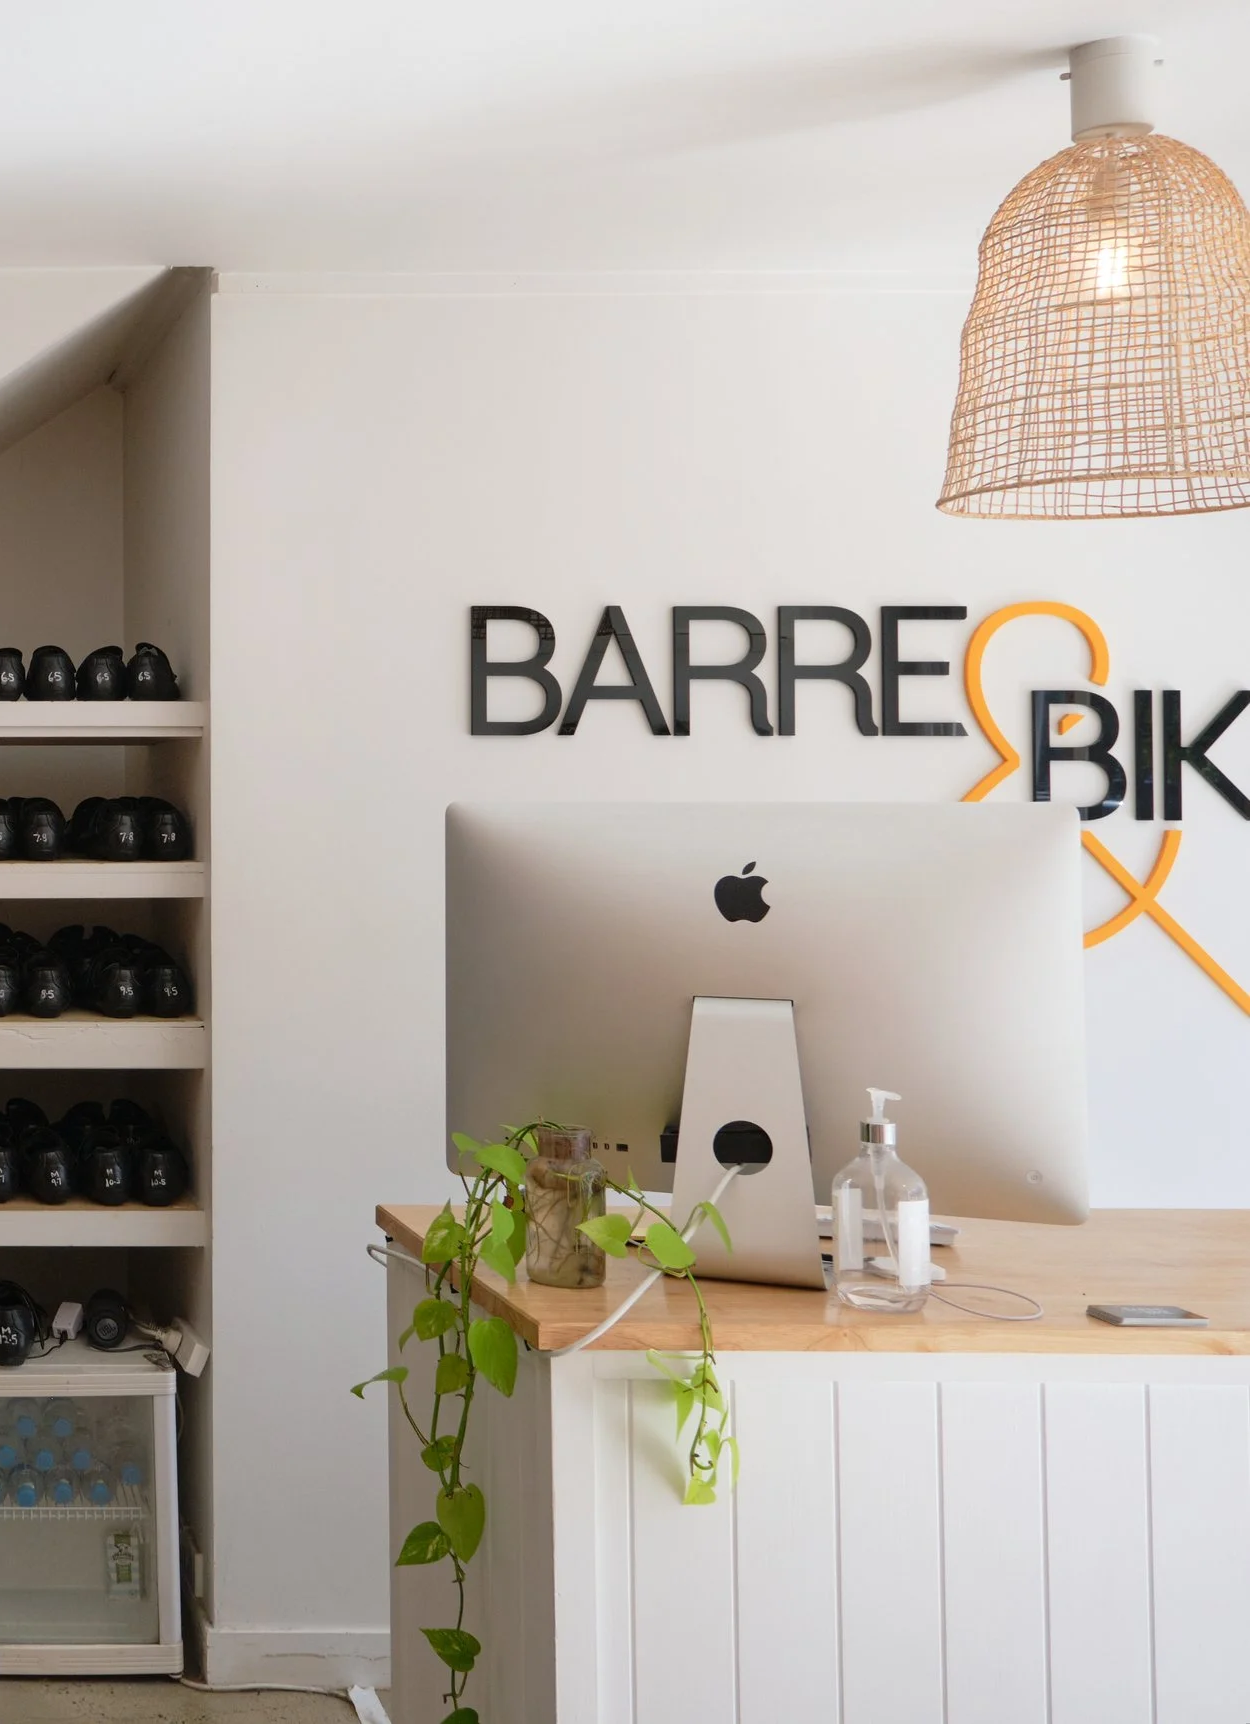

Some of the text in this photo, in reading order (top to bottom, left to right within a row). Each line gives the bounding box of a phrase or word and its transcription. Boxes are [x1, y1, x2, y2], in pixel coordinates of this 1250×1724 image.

[1, 672, 15, 682] 6.5
[48, 671, 62, 682] 6.5
[96, 672, 109, 683] 6.5
[138, 671, 151, 681] 6.5
[469, 605, 968, 737] BARRE
[1031, 689, 1250, 821] BIK
[33, 832, 48, 843] 7.8
[119, 832, 134, 843] 7.8
[161, 832, 176, 843] 7.8
[120, 986, 134, 996] 9.5
[164, 987, 178, 997] 9.5
[154, 1169, 163, 1177] M
[51, 1177, 62, 1186] 9.7
[1, 1327, 12, 1335] M
[0, 1334, 18, 1345] 12.5
